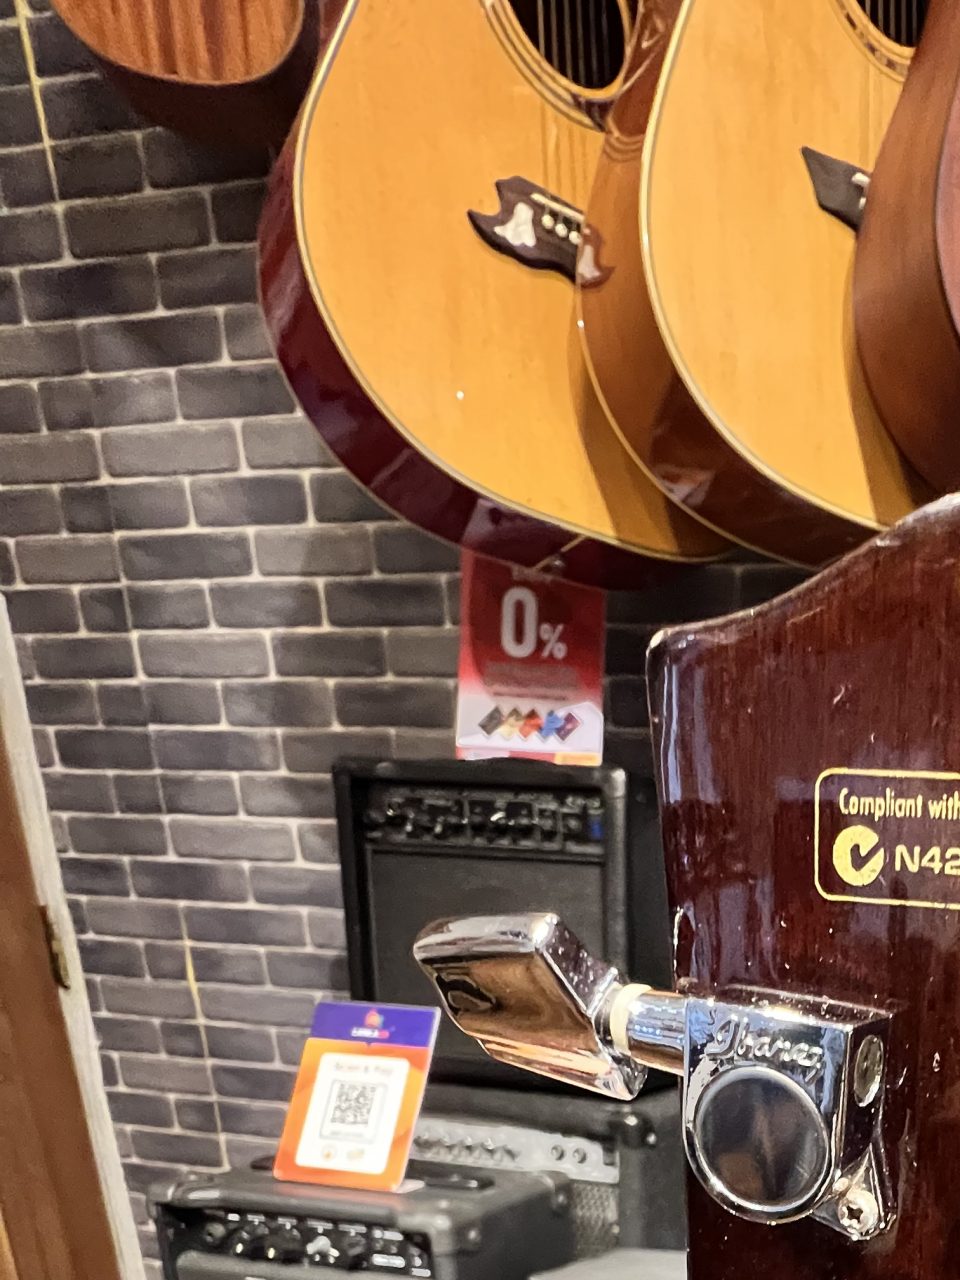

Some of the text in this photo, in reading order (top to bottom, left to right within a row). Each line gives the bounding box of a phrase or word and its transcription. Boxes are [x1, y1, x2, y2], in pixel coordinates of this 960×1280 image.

[502, 586, 569, 660] 0%
[838, 787, 923, 822] Compliant
[700, 1014, 823, 1083] Ibanez
